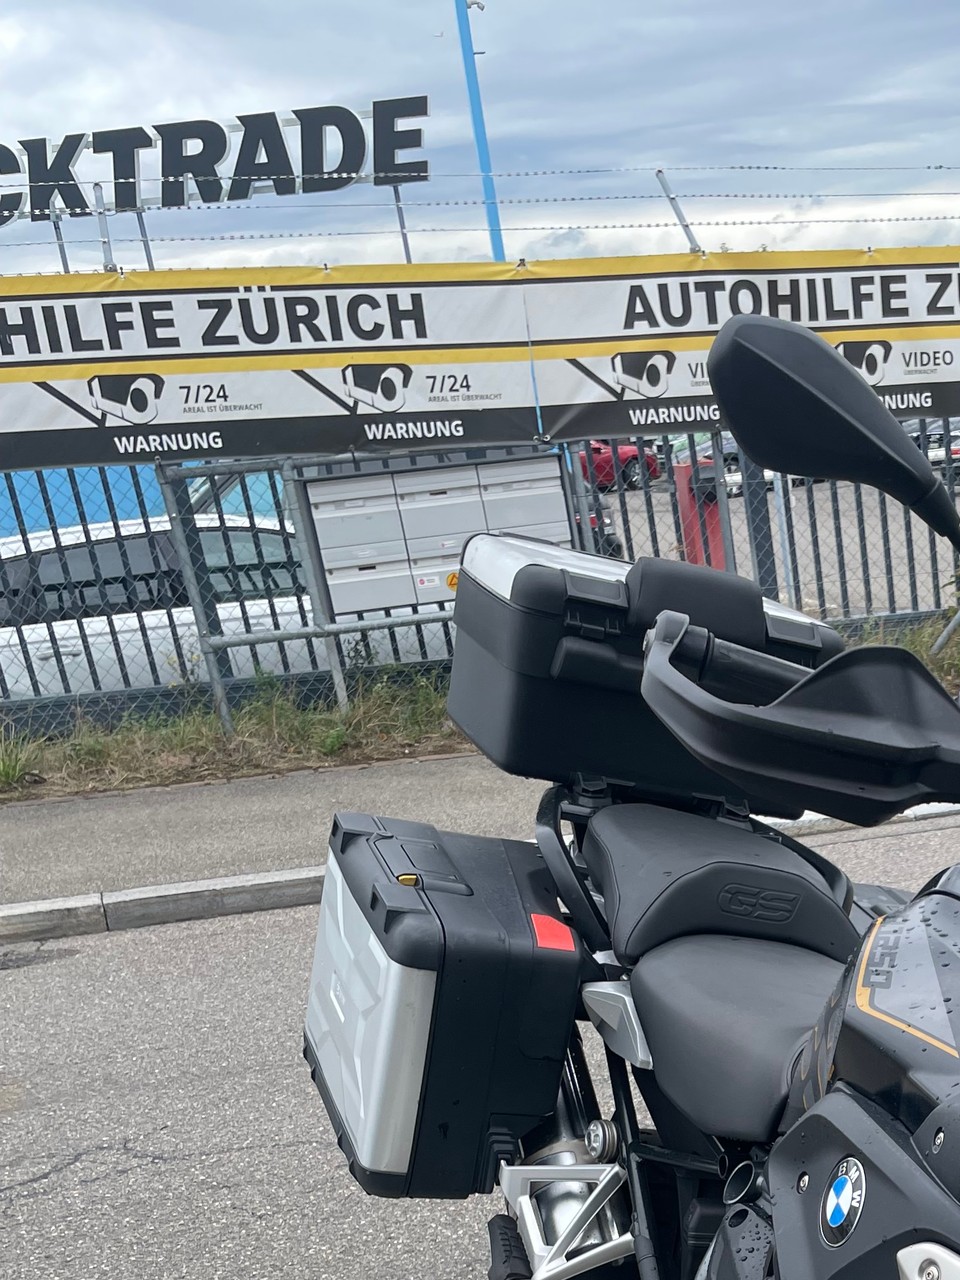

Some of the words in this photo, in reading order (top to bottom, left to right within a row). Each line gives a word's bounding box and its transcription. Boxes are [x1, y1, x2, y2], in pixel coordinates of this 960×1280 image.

[623, 275, 910, 330] AUTOHILFE
[197, 286, 428, 347] ZÜRICH
[902, 350, 954, 368] VIDEO
[178, 384, 229, 404] 7/24
[425, 374, 471, 393] 7/24
[461, 393, 502, 402] ÜBERWACHT
[183, 405, 206, 414] AREAL
[207, 405, 218, 413] IST
[219, 403, 263, 412] ÜBERWACHT
[629, 404, 720, 426] WARNUNG
[364, 420, 465, 440] WARNUNG
[113, 431, 223, 454] WARNUNG
[719, 883, 801, 923] GS
[838, 1162, 862, 1208] BMW
